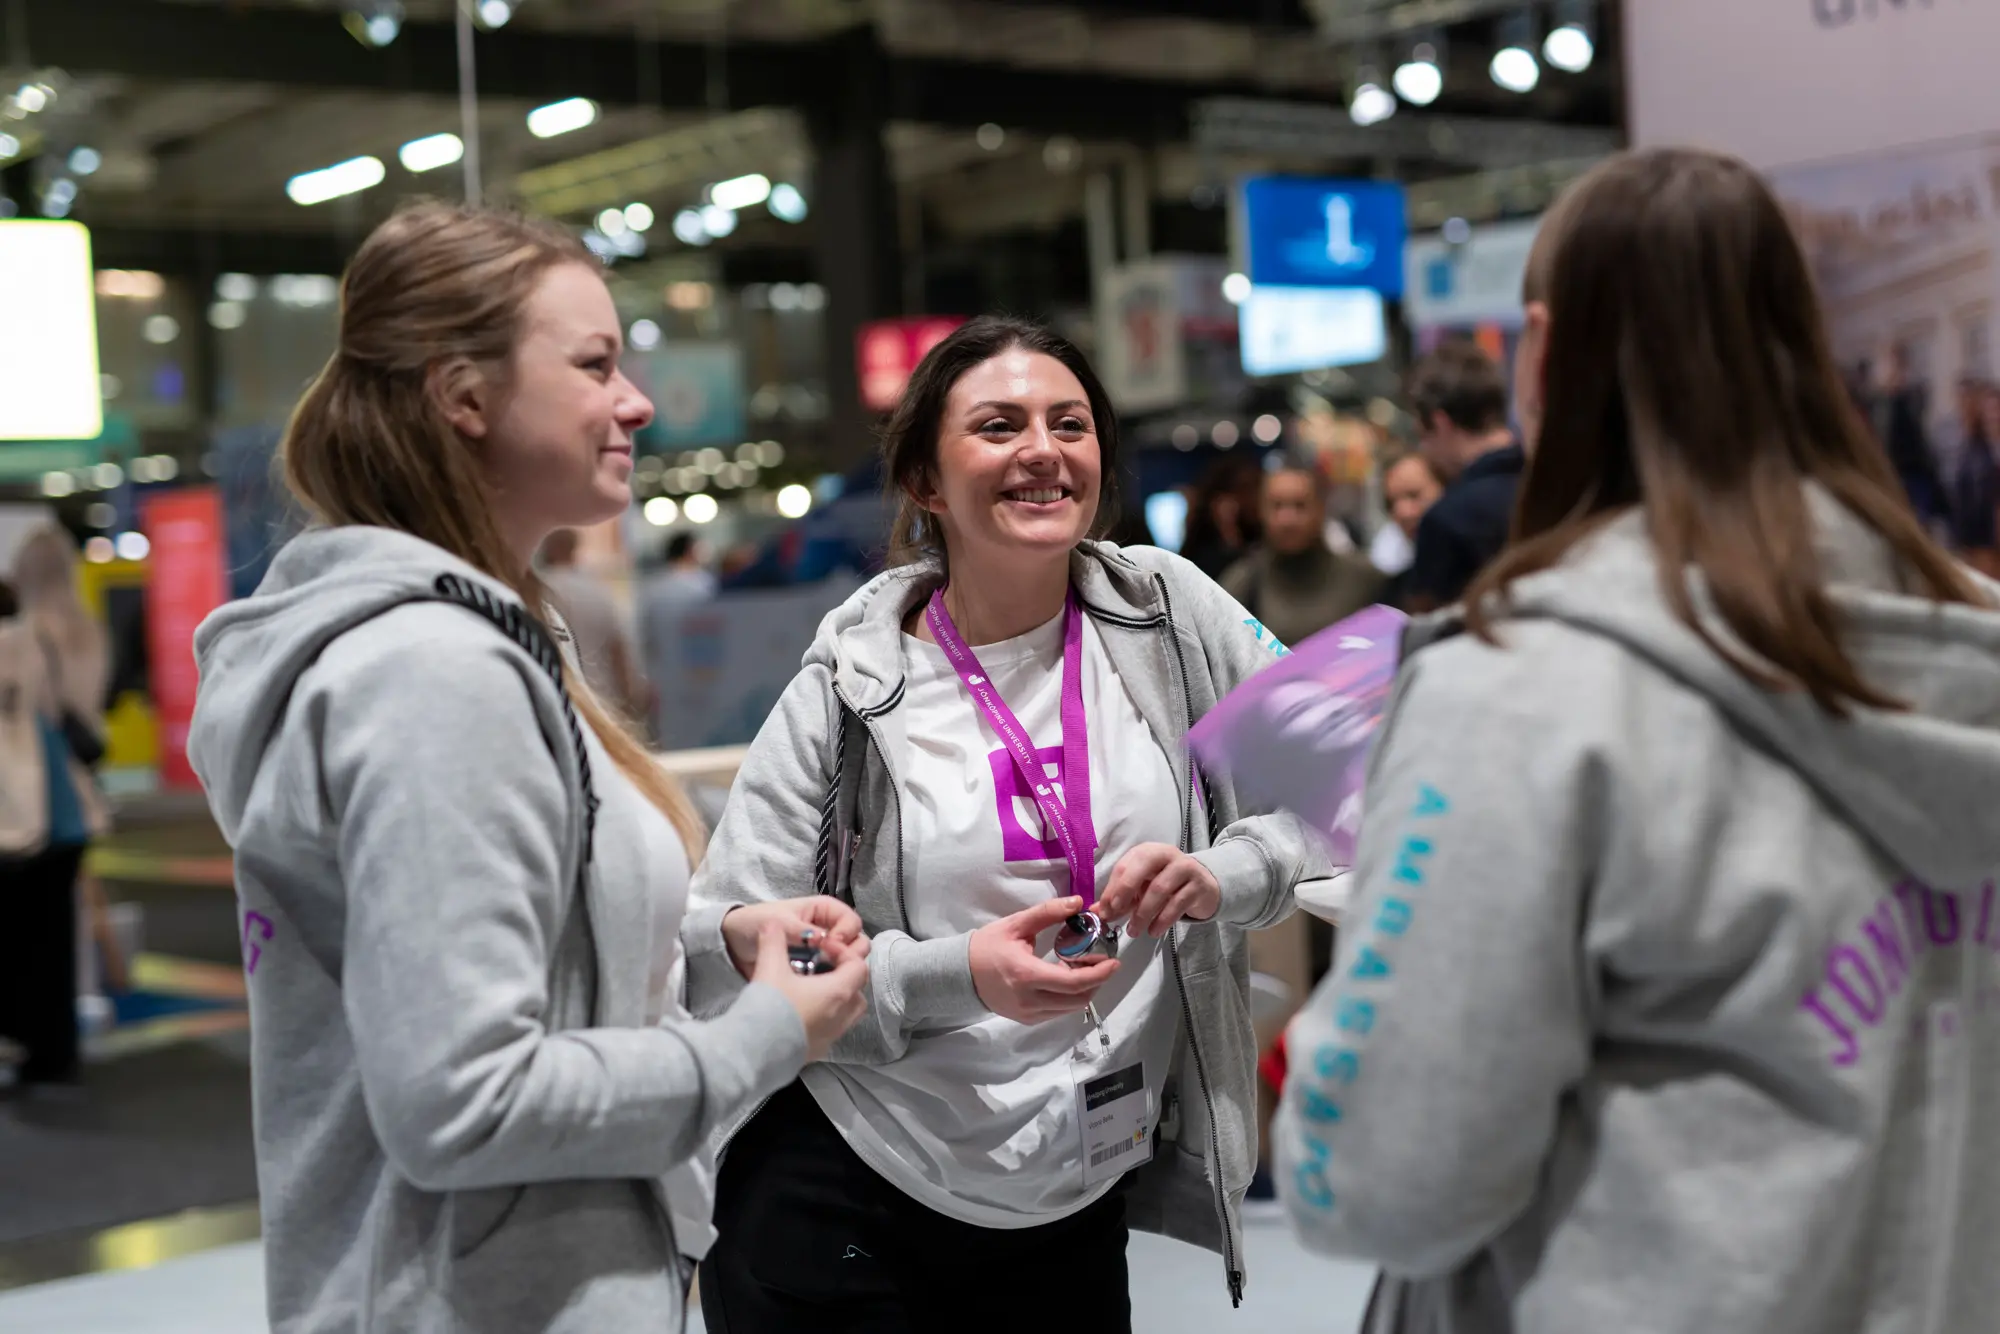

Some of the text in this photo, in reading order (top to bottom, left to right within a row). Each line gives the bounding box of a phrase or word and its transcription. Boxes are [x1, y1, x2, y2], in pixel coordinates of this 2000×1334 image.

[938, 627, 965, 661] UNIVERSITY
[977, 687, 1033, 765] JÖNKÖPING UNIVERSITY
